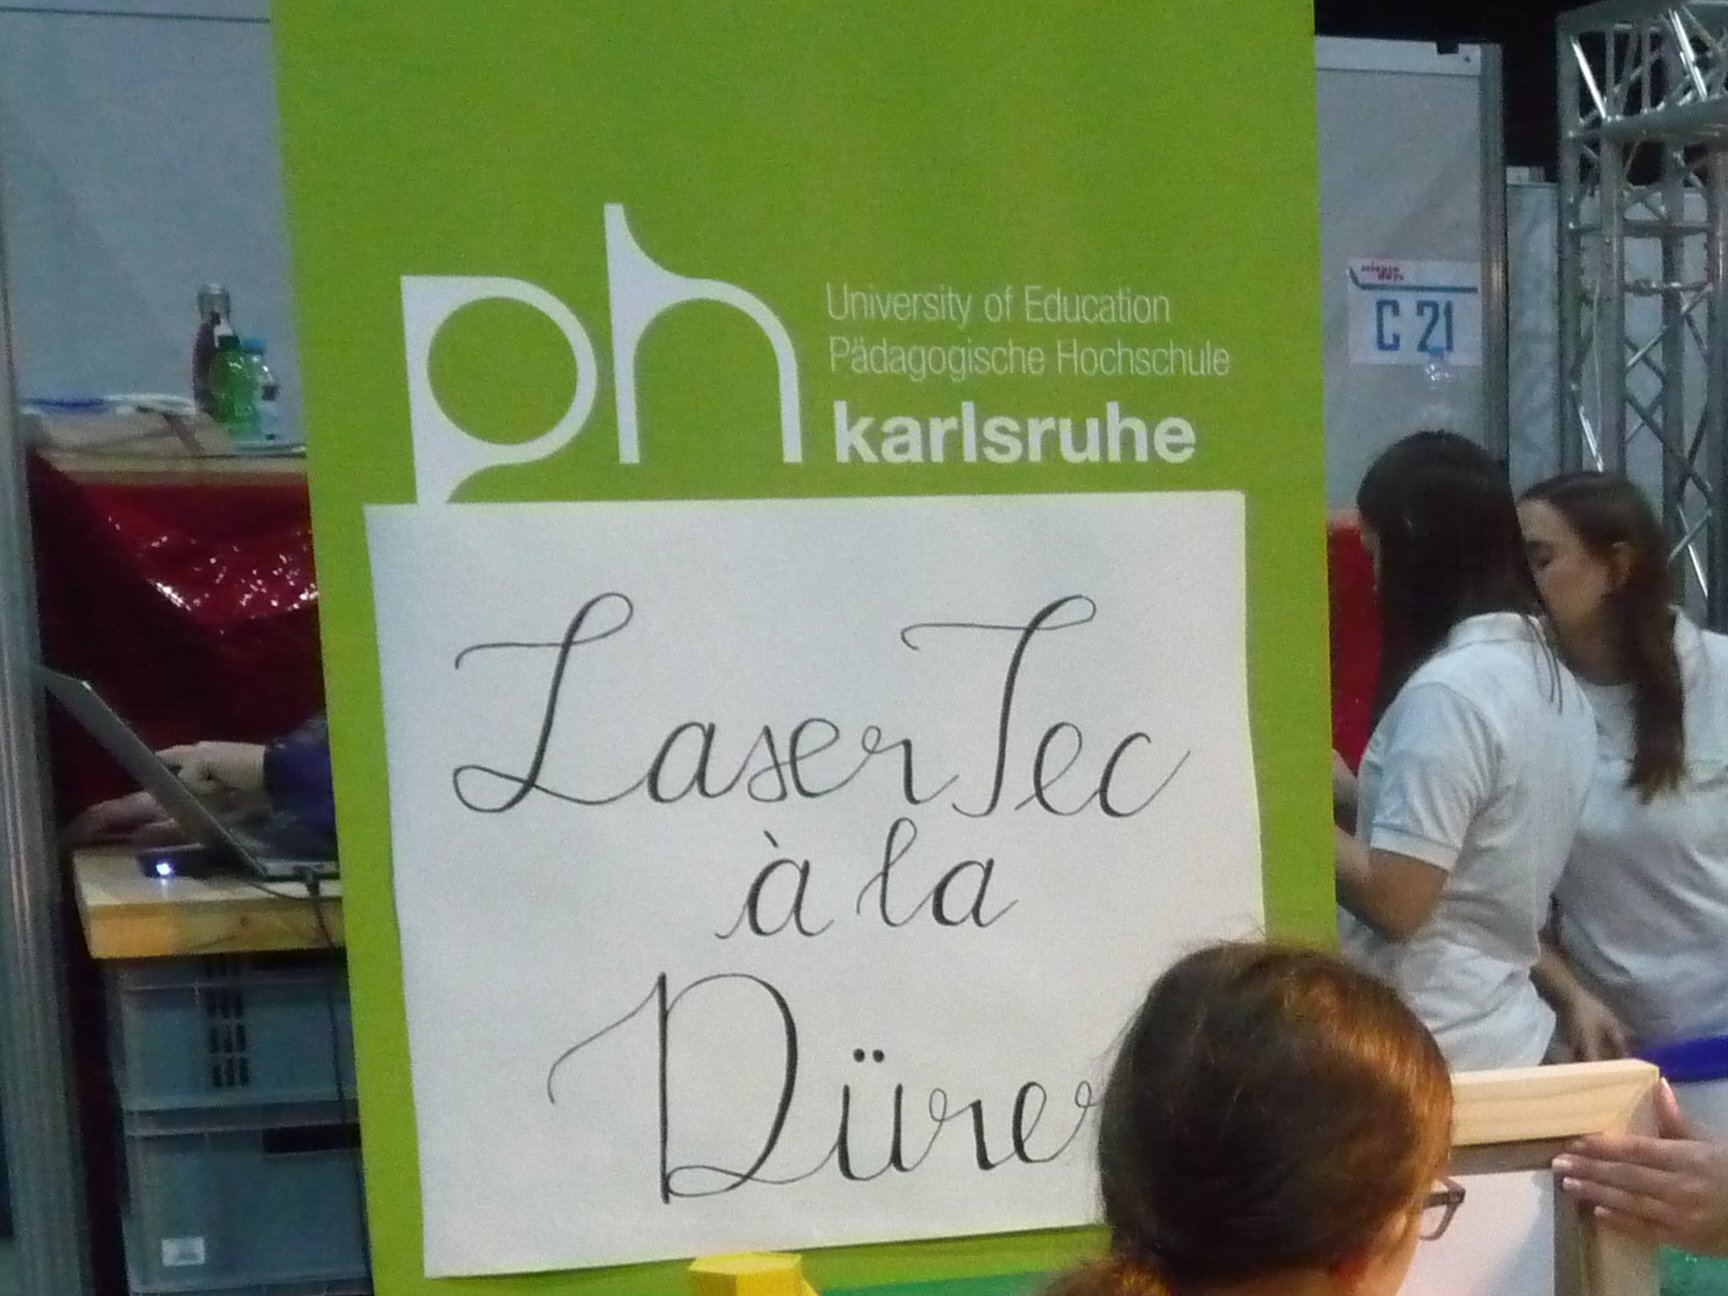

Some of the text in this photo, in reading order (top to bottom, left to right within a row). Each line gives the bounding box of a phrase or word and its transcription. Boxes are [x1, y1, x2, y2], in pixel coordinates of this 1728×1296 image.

[825, 282, 1171, 330] University of Education
[1375, 299, 1454, 353] C 21
[400, 203, 801, 503] ph
[829, 335, 1231, 384] Pädagogische Hochschule
[833, 400, 1197, 464] karlsruhe
[715, 816, 1020, 940] à la
